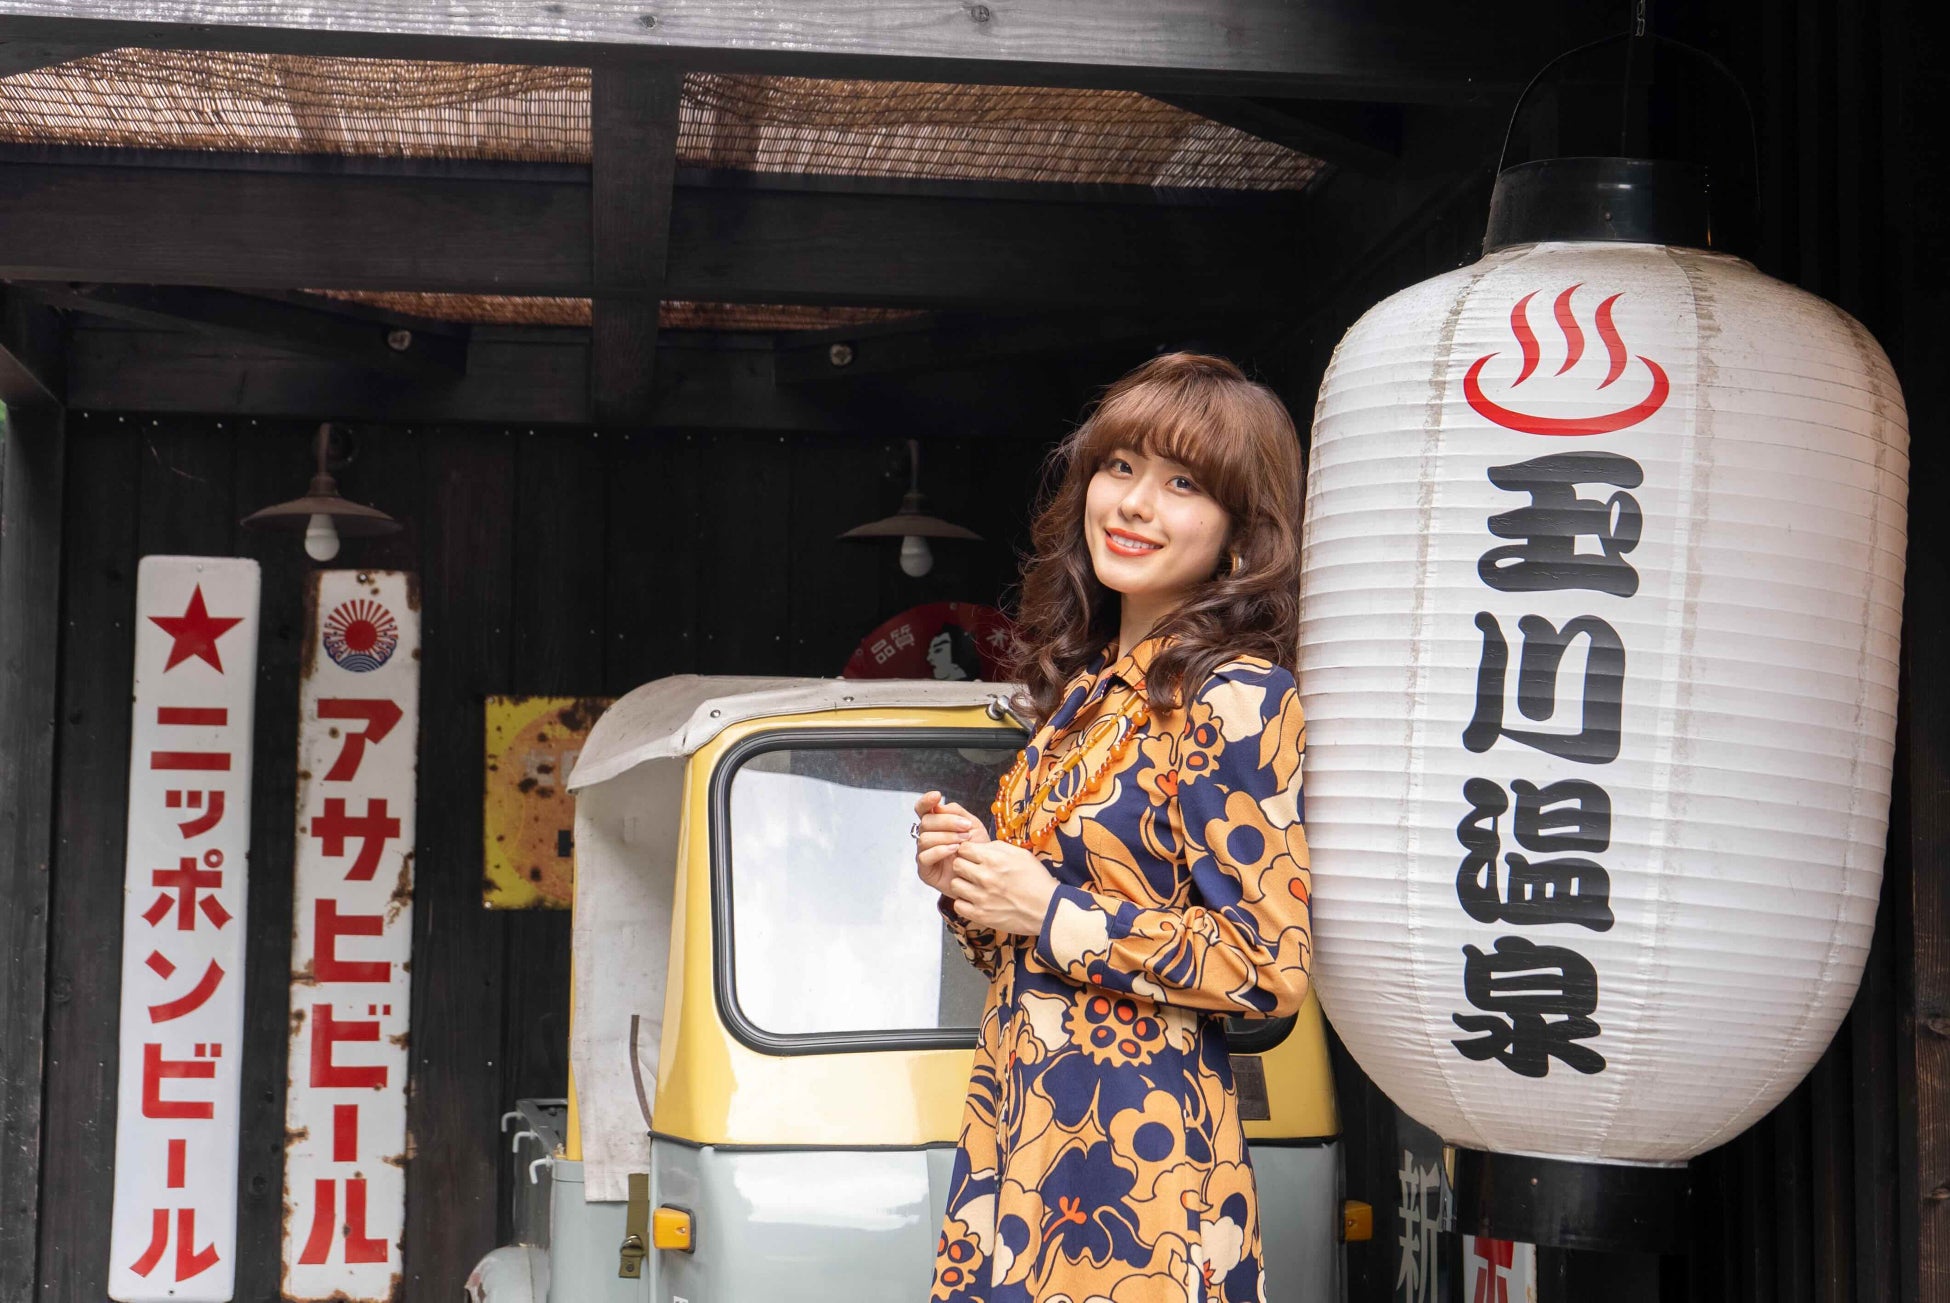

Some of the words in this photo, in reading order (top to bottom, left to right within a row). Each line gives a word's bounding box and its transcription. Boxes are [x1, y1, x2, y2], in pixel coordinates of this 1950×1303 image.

[131, 708, 230, 1282] ニッポンビール
[299, 700, 402, 1264] アサヒビール
[1451, 451, 1643, 1078] 玉川温泉
